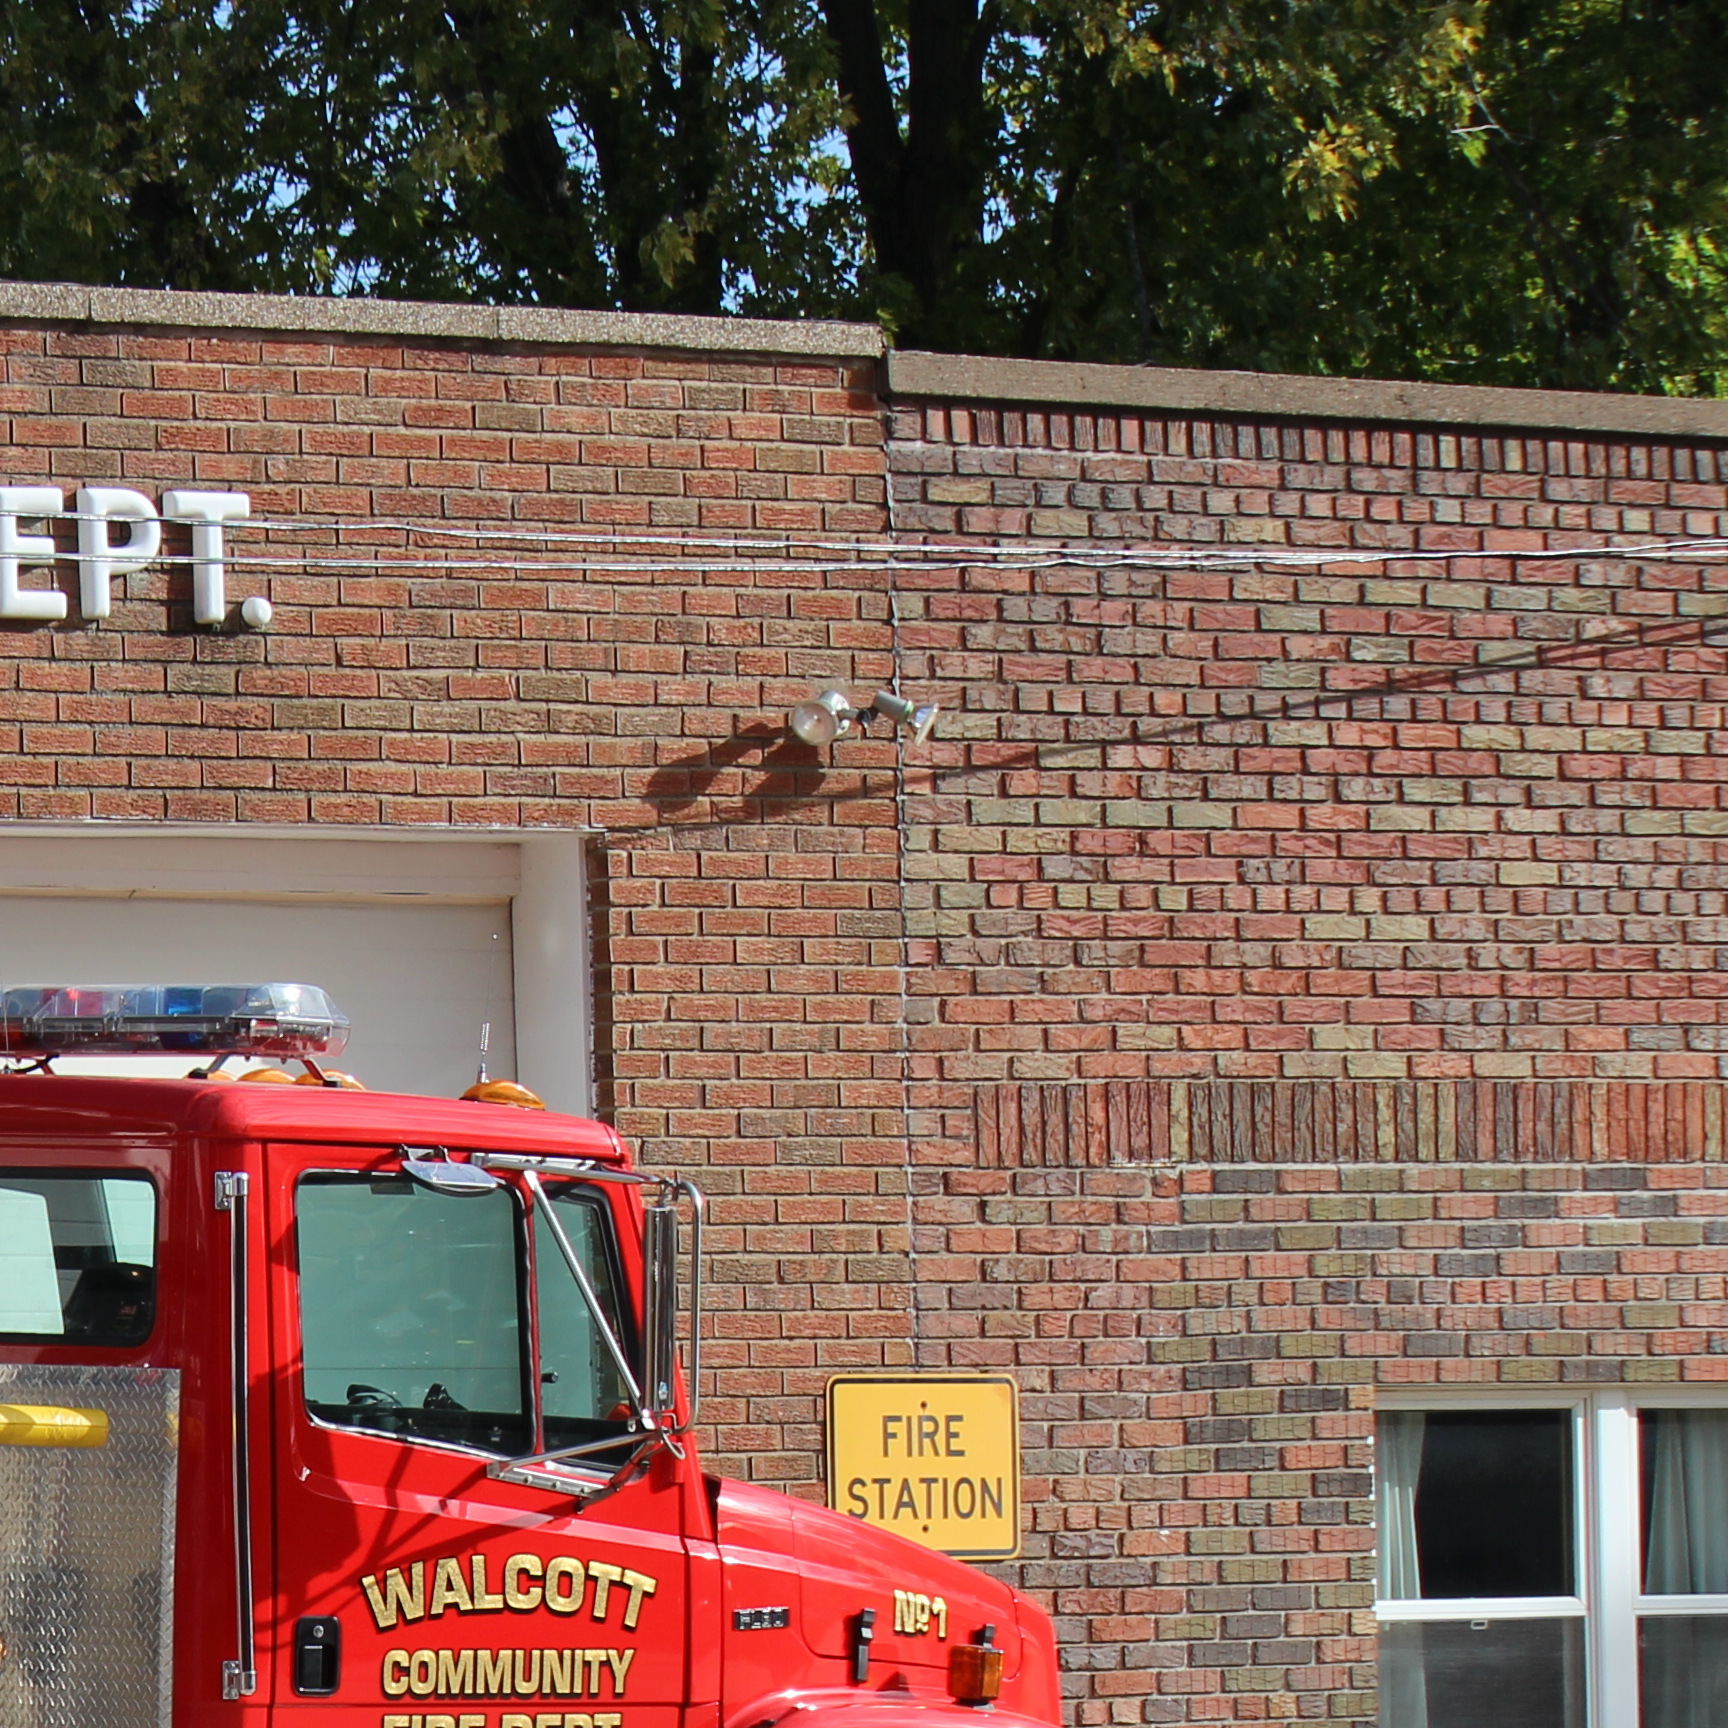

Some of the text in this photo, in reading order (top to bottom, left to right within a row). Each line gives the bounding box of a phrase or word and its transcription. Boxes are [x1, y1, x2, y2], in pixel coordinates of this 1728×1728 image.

[882, 1414, 968, 1458] FIRE
[846, 1476, 1004, 1522] STATION
[360, 1553, 657, 1631] WALCOTT
[382, 1649, 636, 1697] COMMUNITY
